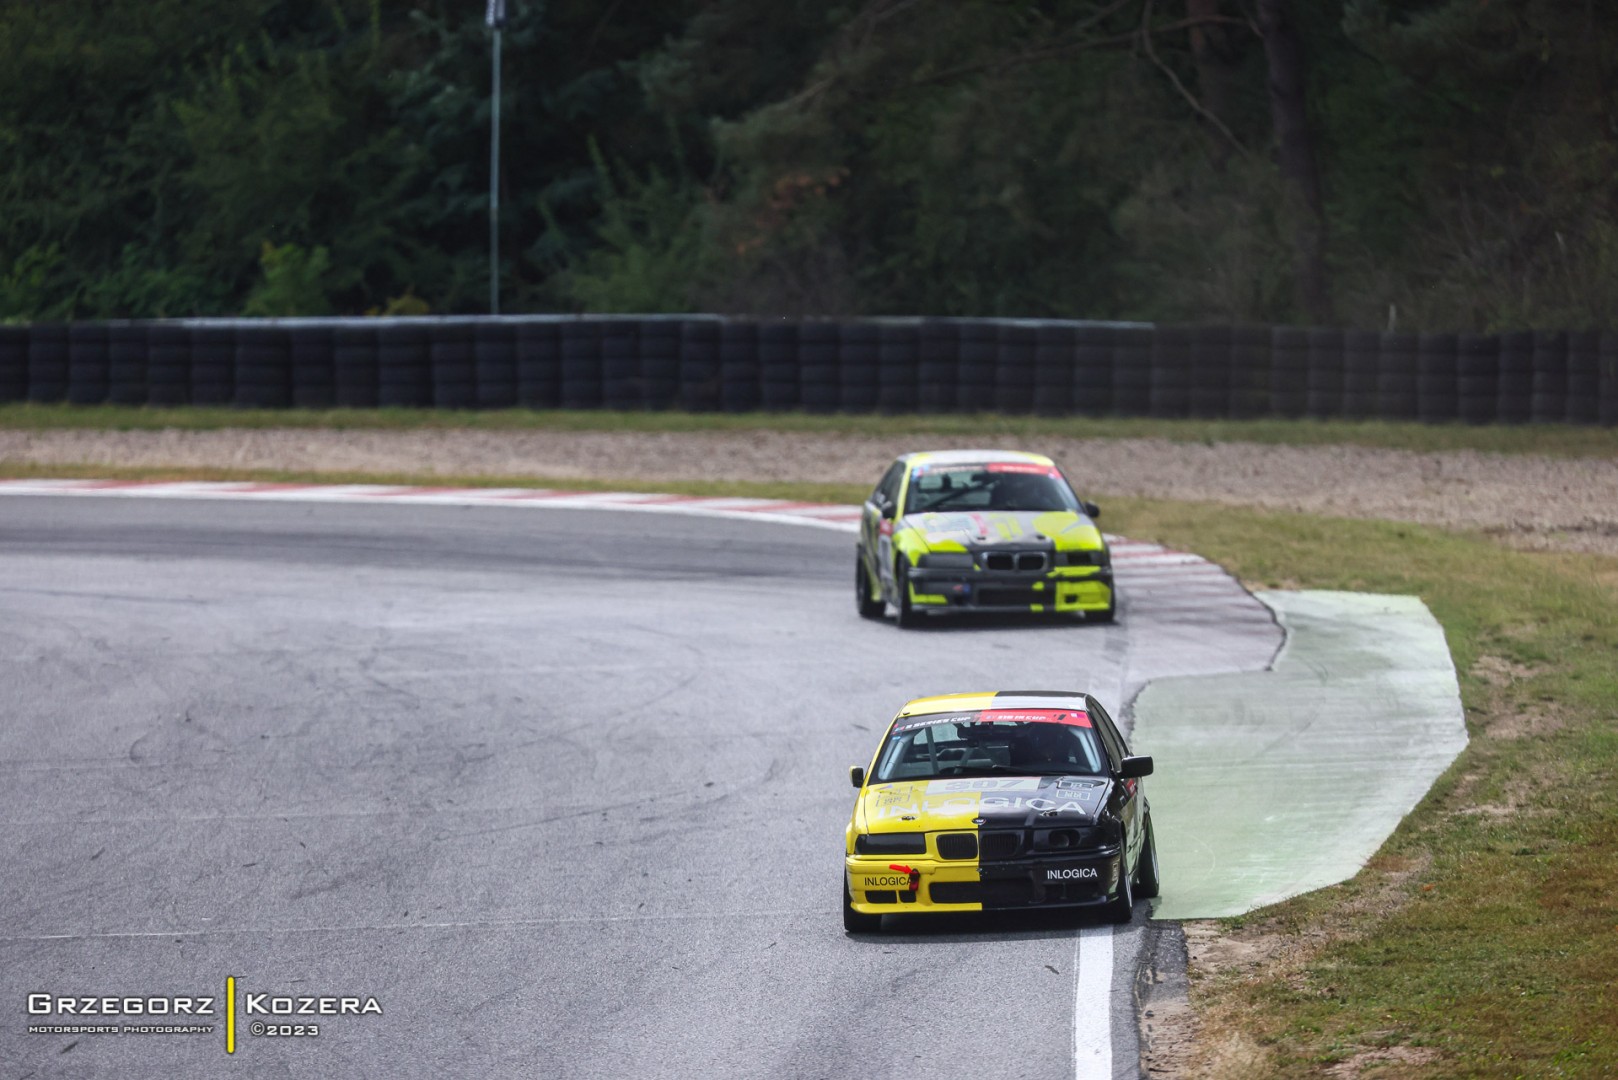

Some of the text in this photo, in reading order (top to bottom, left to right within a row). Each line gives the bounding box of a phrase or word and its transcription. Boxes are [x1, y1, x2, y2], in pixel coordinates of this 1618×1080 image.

[945, 779, 1024, 790] 307
[878, 797, 1087, 817] INLOGICA
[1046, 867, 1099, 880] INLOGICA
